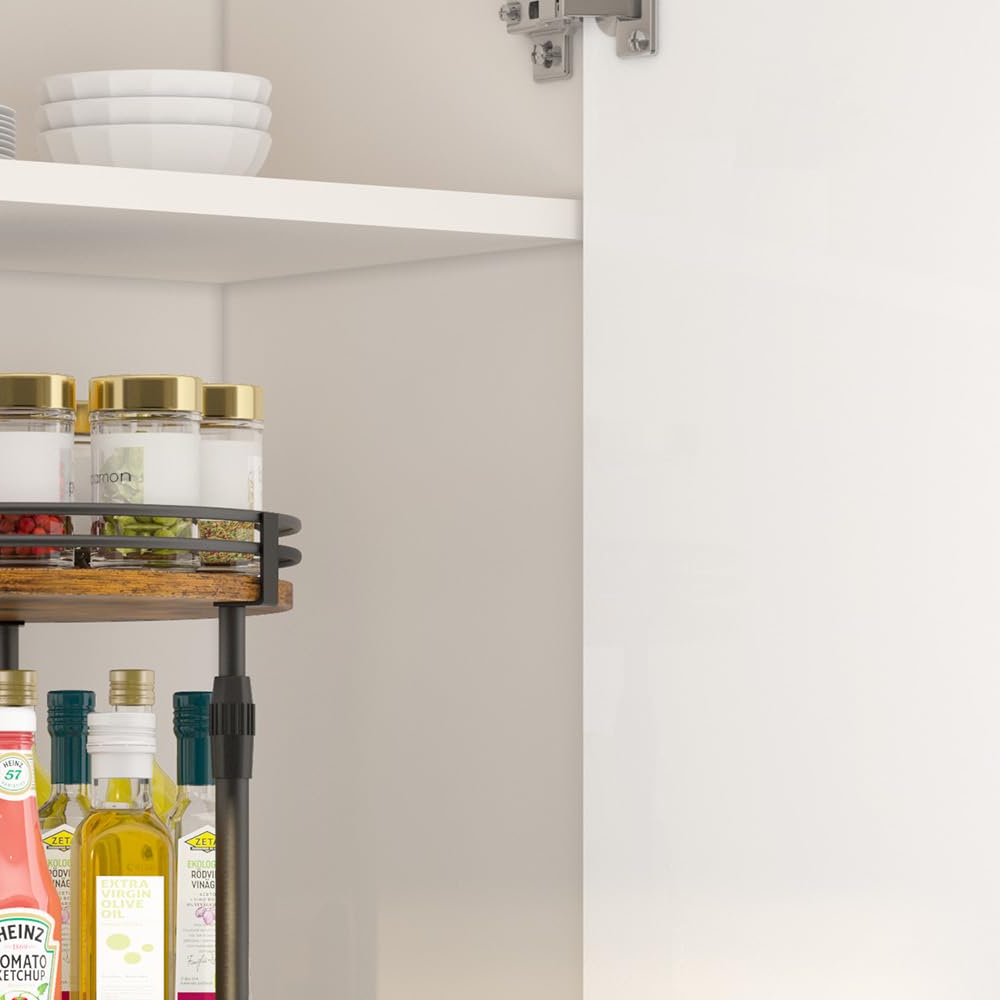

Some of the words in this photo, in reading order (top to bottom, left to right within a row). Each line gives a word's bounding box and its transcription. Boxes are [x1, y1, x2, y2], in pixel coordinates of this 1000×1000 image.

[3, 760, 24, 768] HEINZ
[4, 769, 22, 780] 57
[52, 836, 71, 845] ZET
[101, 879, 149, 889] EXTRA
[191, 878, 216, 889] VINÄG
[101, 889, 152, 899] VIRGIN
[101, 899, 145, 909] OLIVE
[101, 909, 125, 919] OIL
